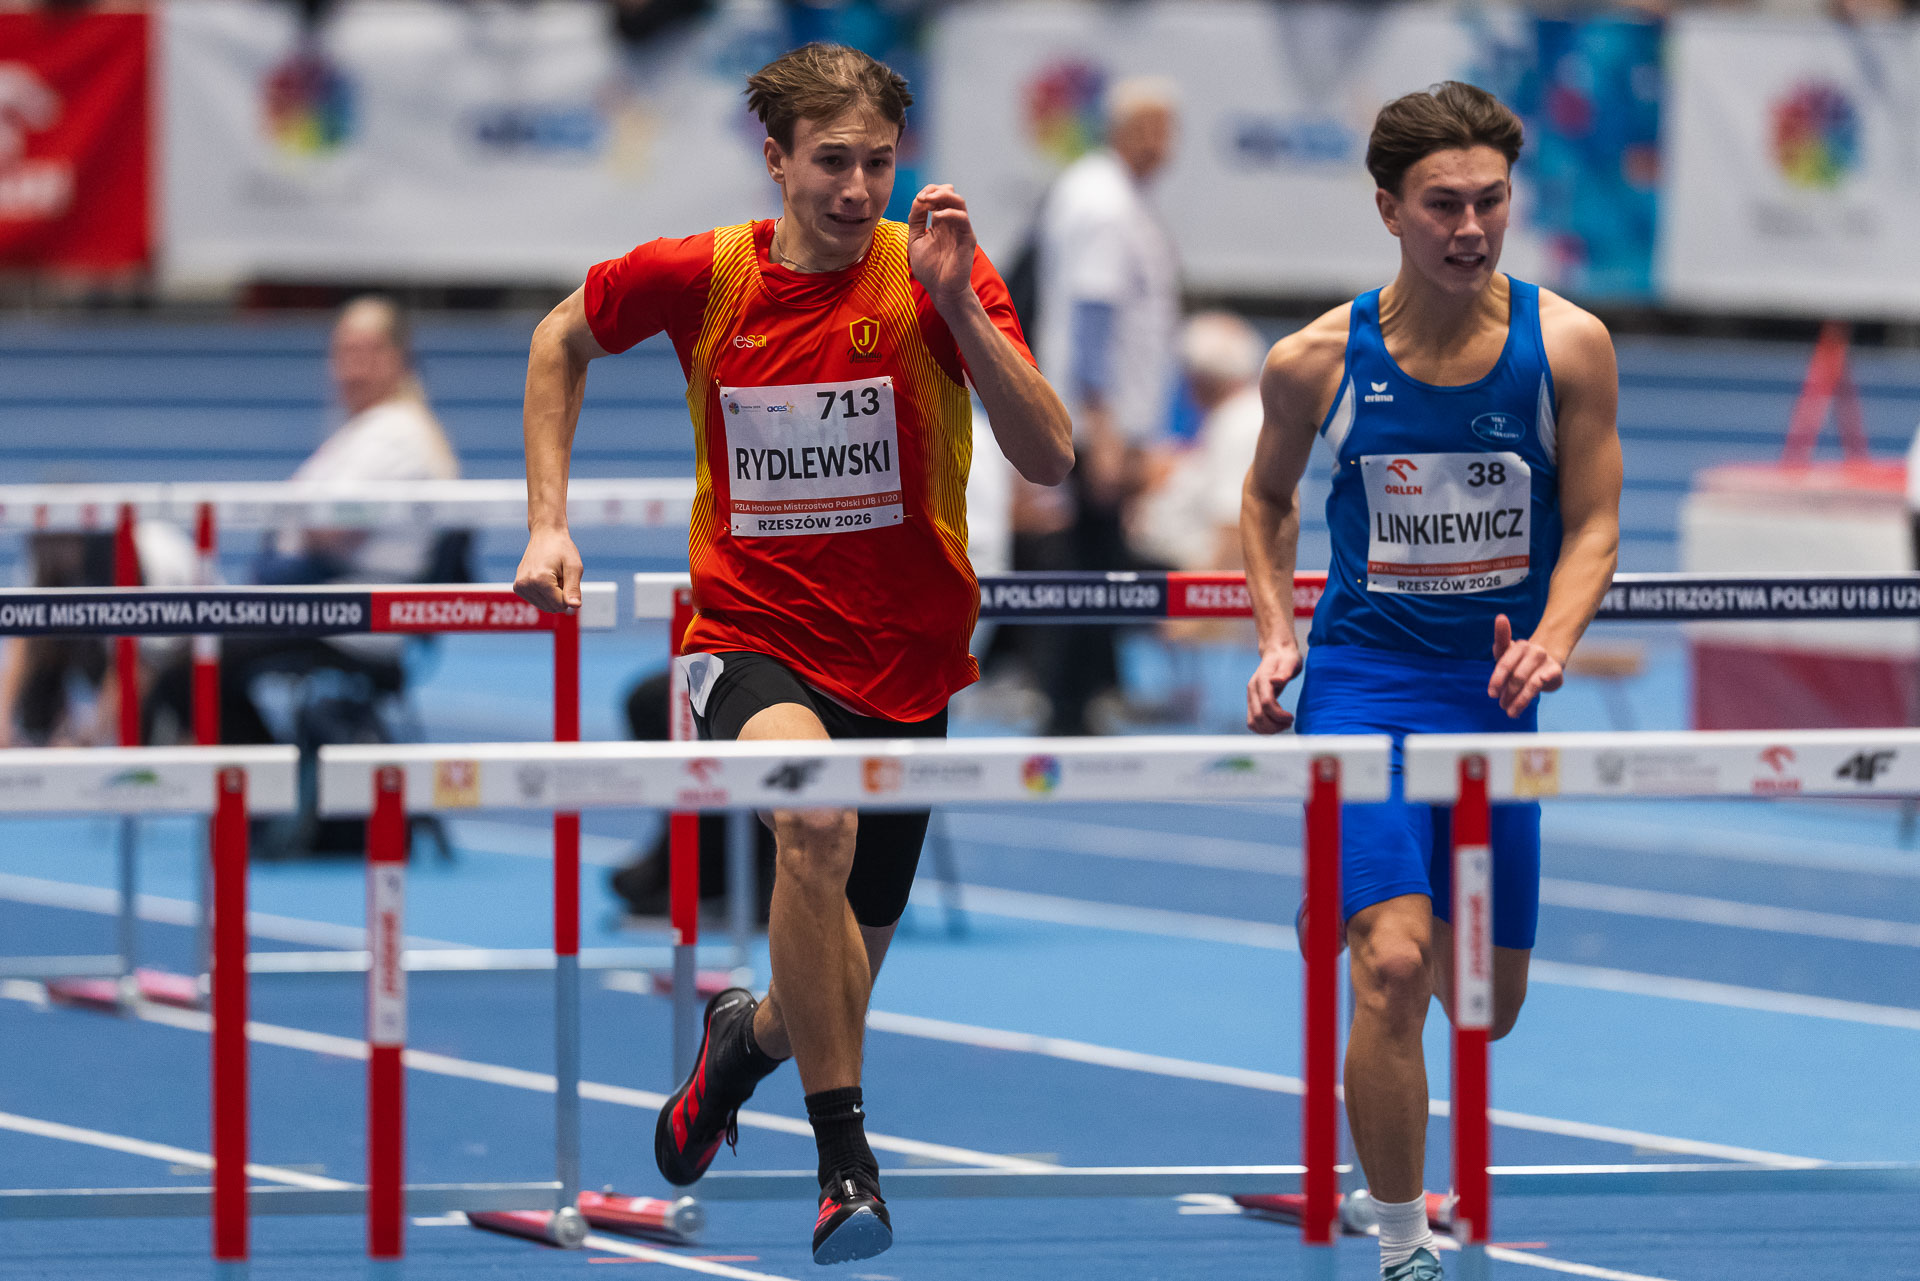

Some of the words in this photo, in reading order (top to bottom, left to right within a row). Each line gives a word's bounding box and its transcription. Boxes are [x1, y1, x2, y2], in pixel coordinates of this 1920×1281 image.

[858, 325, 870, 346] J
[817, 387, 880, 420] 713
[1365, 393, 1394, 402] erima
[736, 440, 891, 481] RYDLEWSKI
[1467, 462, 1506, 487] 38
[1385, 485, 1422, 495] ORLEN
[735, 503, 750, 511] PZLA
[752, 504, 782, 512] Halowe
[784, 502, 834, 511] Mistrzostwa
[836, 499, 861, 508] Polski
[862, 497, 876, 506] U18
[882, 494, 898, 503] U20
[758, 515, 831, 531] RZESZÓW
[835, 513, 872, 527] 2026
[1377, 508, 1524, 545] LINKIEWICZ
[1397, 577, 1466, 591] RZESZÓW
[1470, 576, 1501, 589] 2026
[998, 585, 1066, 608] POLSKI
[1067, 585, 1106, 608] U18
[1120, 585, 1159, 608] U20
[1629, 586, 1769, 611] MISTRZOSTWA
[1771, 585, 1839, 610] POLSKI
[1842, 585, 1878, 609] U18
[51, 602, 193, 626] MISTRZOSTWA
[197, 602, 267, 625] POLSKI
[270, 602, 309, 625] U18
[322, 602, 362, 624] U20
[389, 597, 487, 625] RZESZÓW
[489, 602, 539, 624] 2026
